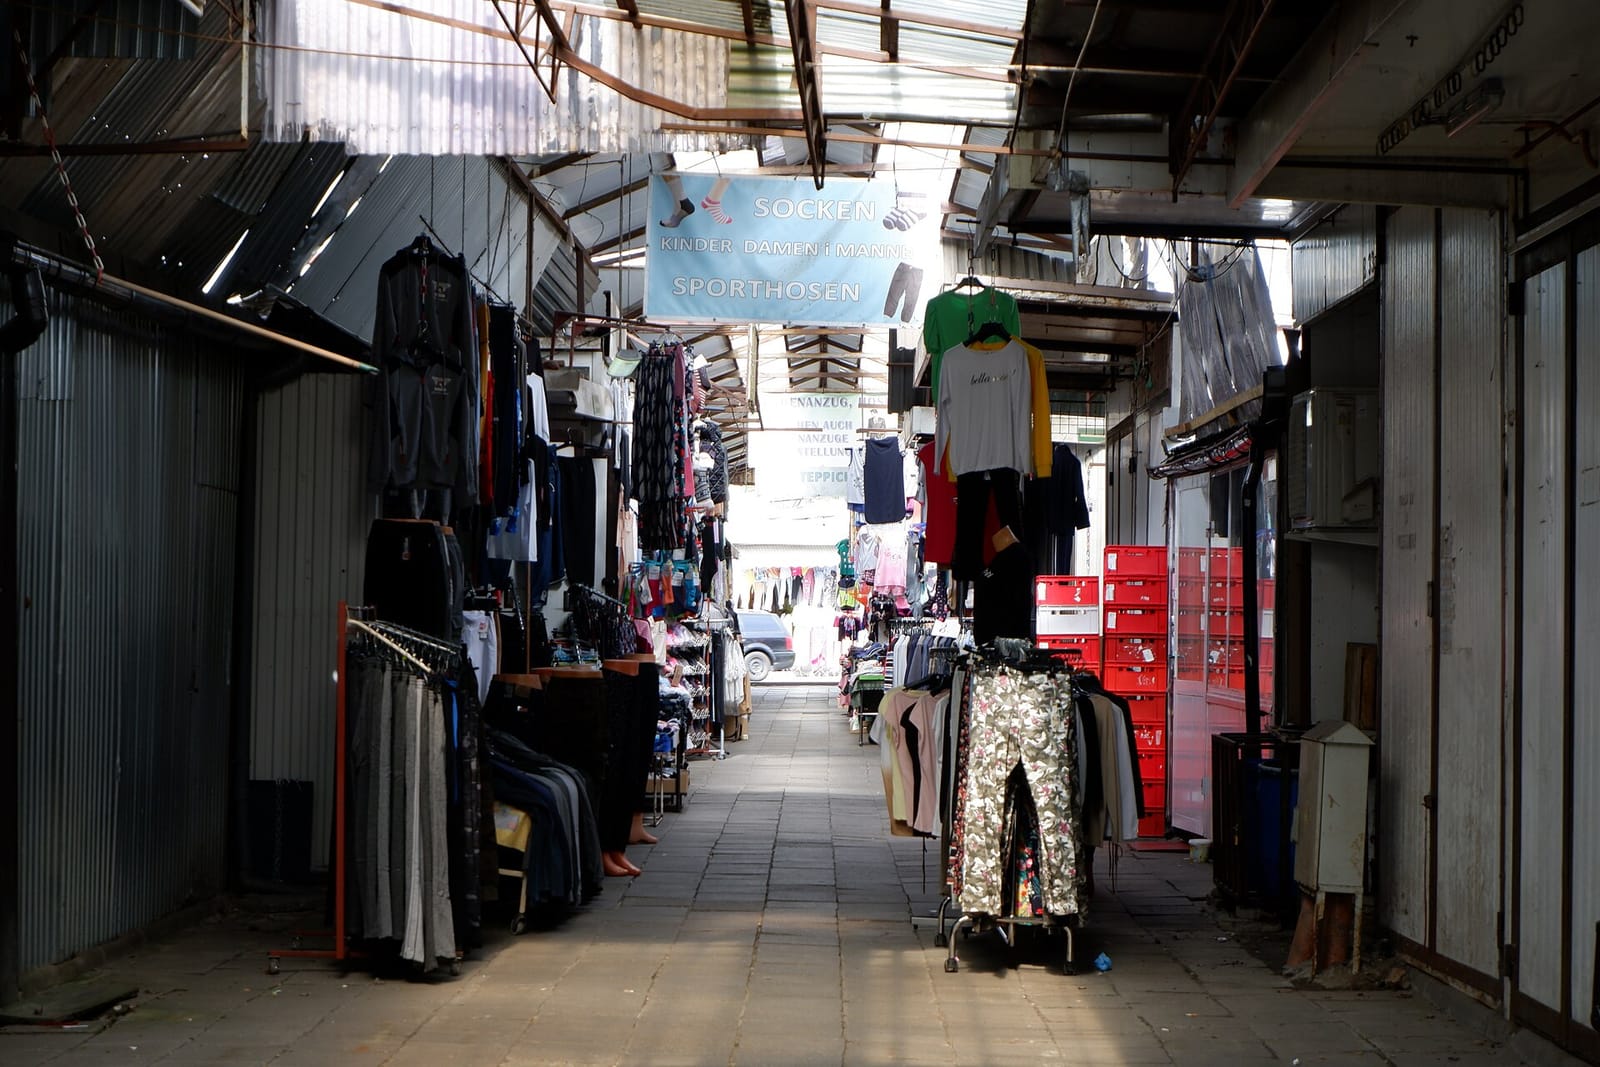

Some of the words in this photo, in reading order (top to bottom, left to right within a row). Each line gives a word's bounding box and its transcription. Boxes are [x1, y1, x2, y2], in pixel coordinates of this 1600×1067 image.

[754, 197, 876, 221] SOCKEN
[660, 236, 733, 254] KINDER
[743, 239, 819, 257] DAMEN
[824, 242, 830, 256] i
[672, 277, 860, 302] SPORTHOSEN
[789, 397, 853, 409] ENANZUG,
[823, 420, 853, 430] AUCH
